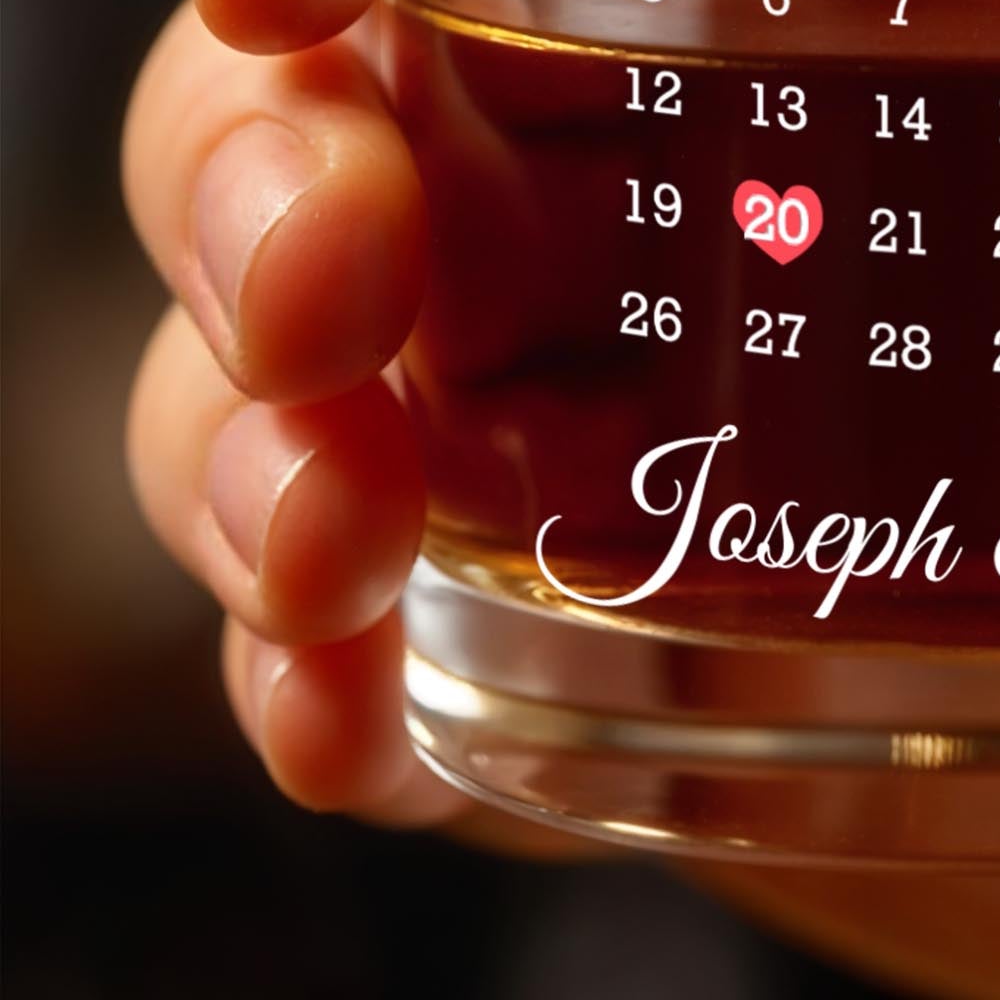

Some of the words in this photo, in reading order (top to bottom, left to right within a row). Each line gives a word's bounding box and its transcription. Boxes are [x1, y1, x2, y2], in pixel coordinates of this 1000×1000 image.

[625, 67, 683, 116] 12
[749, 82, 808, 131] 13
[874, 94, 932, 141] 14
[625, 178, 683, 228] 19
[744, 194, 810, 245] 20
[869, 208, 928, 255] 21
[619, 291, 683, 342] 26
[744, 309, 807, 358] 27
[868, 322, 932, 370] 28
[535, 424, 963, 618] Joseph
